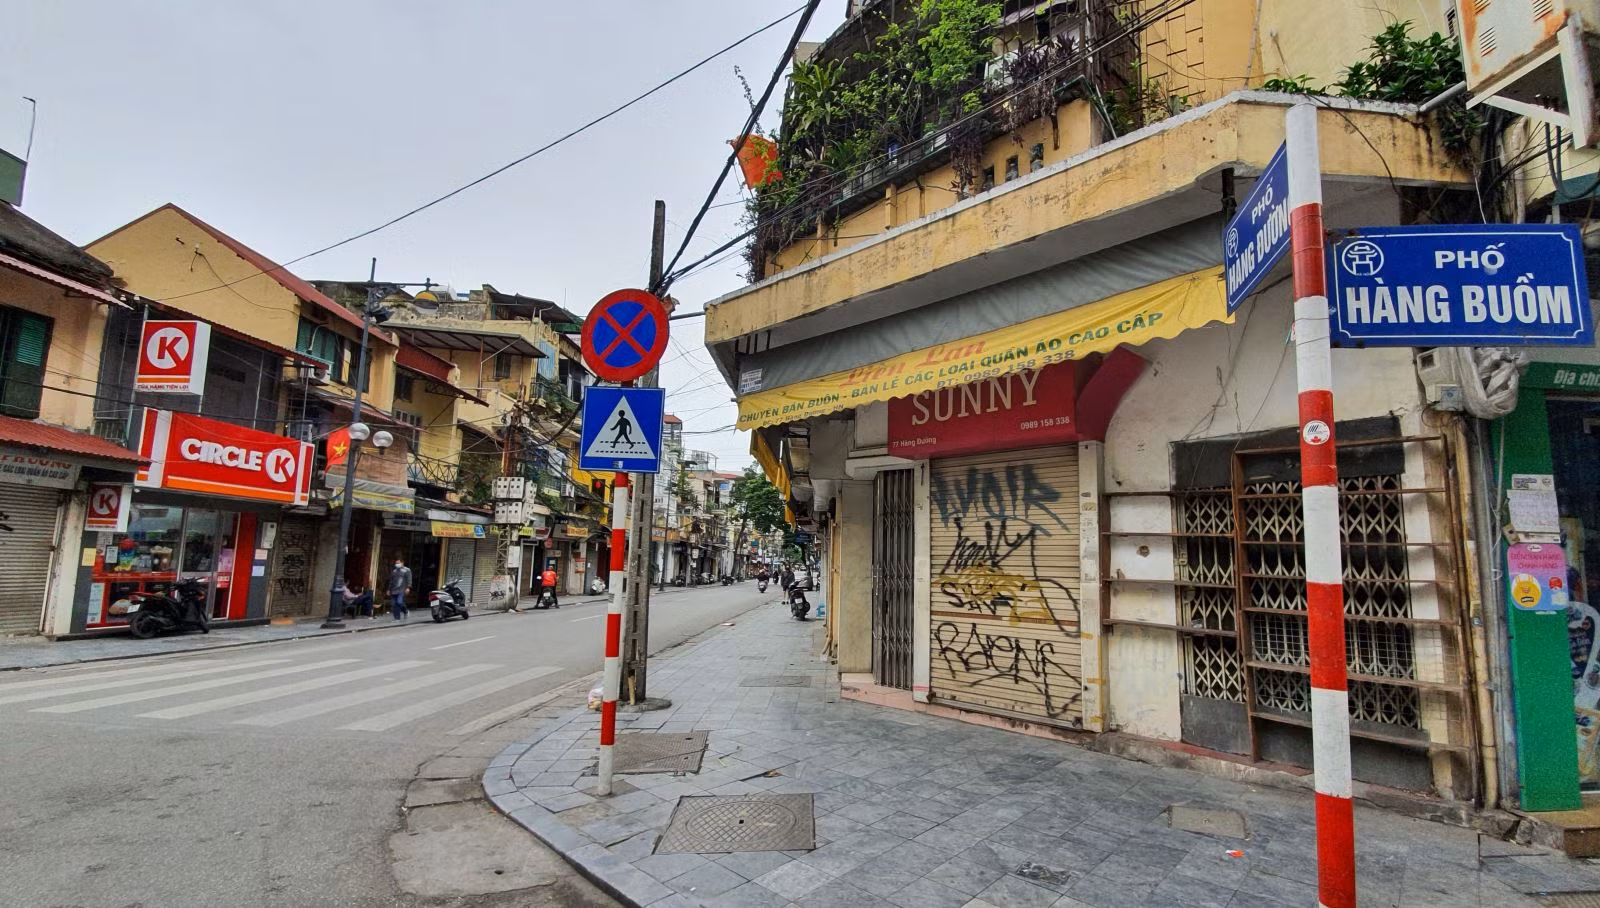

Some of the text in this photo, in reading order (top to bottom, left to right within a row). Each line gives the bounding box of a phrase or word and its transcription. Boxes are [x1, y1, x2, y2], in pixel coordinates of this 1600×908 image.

[1251, 177, 1275, 225] PHỐ
[1229, 241, 1255, 296] HÀNG
[1434, 242, 1507, 270] PHỐ
[1345, 272, 1573, 324] HÀNG BUỒM
[740, 406, 780, 423] CHUYÊN
[782, 401, 805, 414] BÁN
[807, 393, 840, 408] BUÔN
[851, 381, 879, 398] BÁN
[882, 377, 900, 391] LẺ
[904, 369, 935, 386] CÁC
[938, 361, 975, 378] LOẠI
[980, 344, 1029, 368] QUẦN
[1035, 337, 1062, 353] ÁO
[1068, 327, 1110, 345] CAO
[1116, 310, 1163, 334] CẤP
[915, 339, 987, 369] Lan
[963, 367, 1001, 383] 0989
[1007, 358, 1037, 374] 158
[1043, 349, 1076, 364] 338
[1553, 369, 1577, 389] Địa
[912, 367, 1044, 426] SUNNY
[1020, 416, 1070, 431] 0989 158 338
[181, 438, 264, 472] CIRCLE
[892, 436, 937, 449] 77 Hàng Đường
